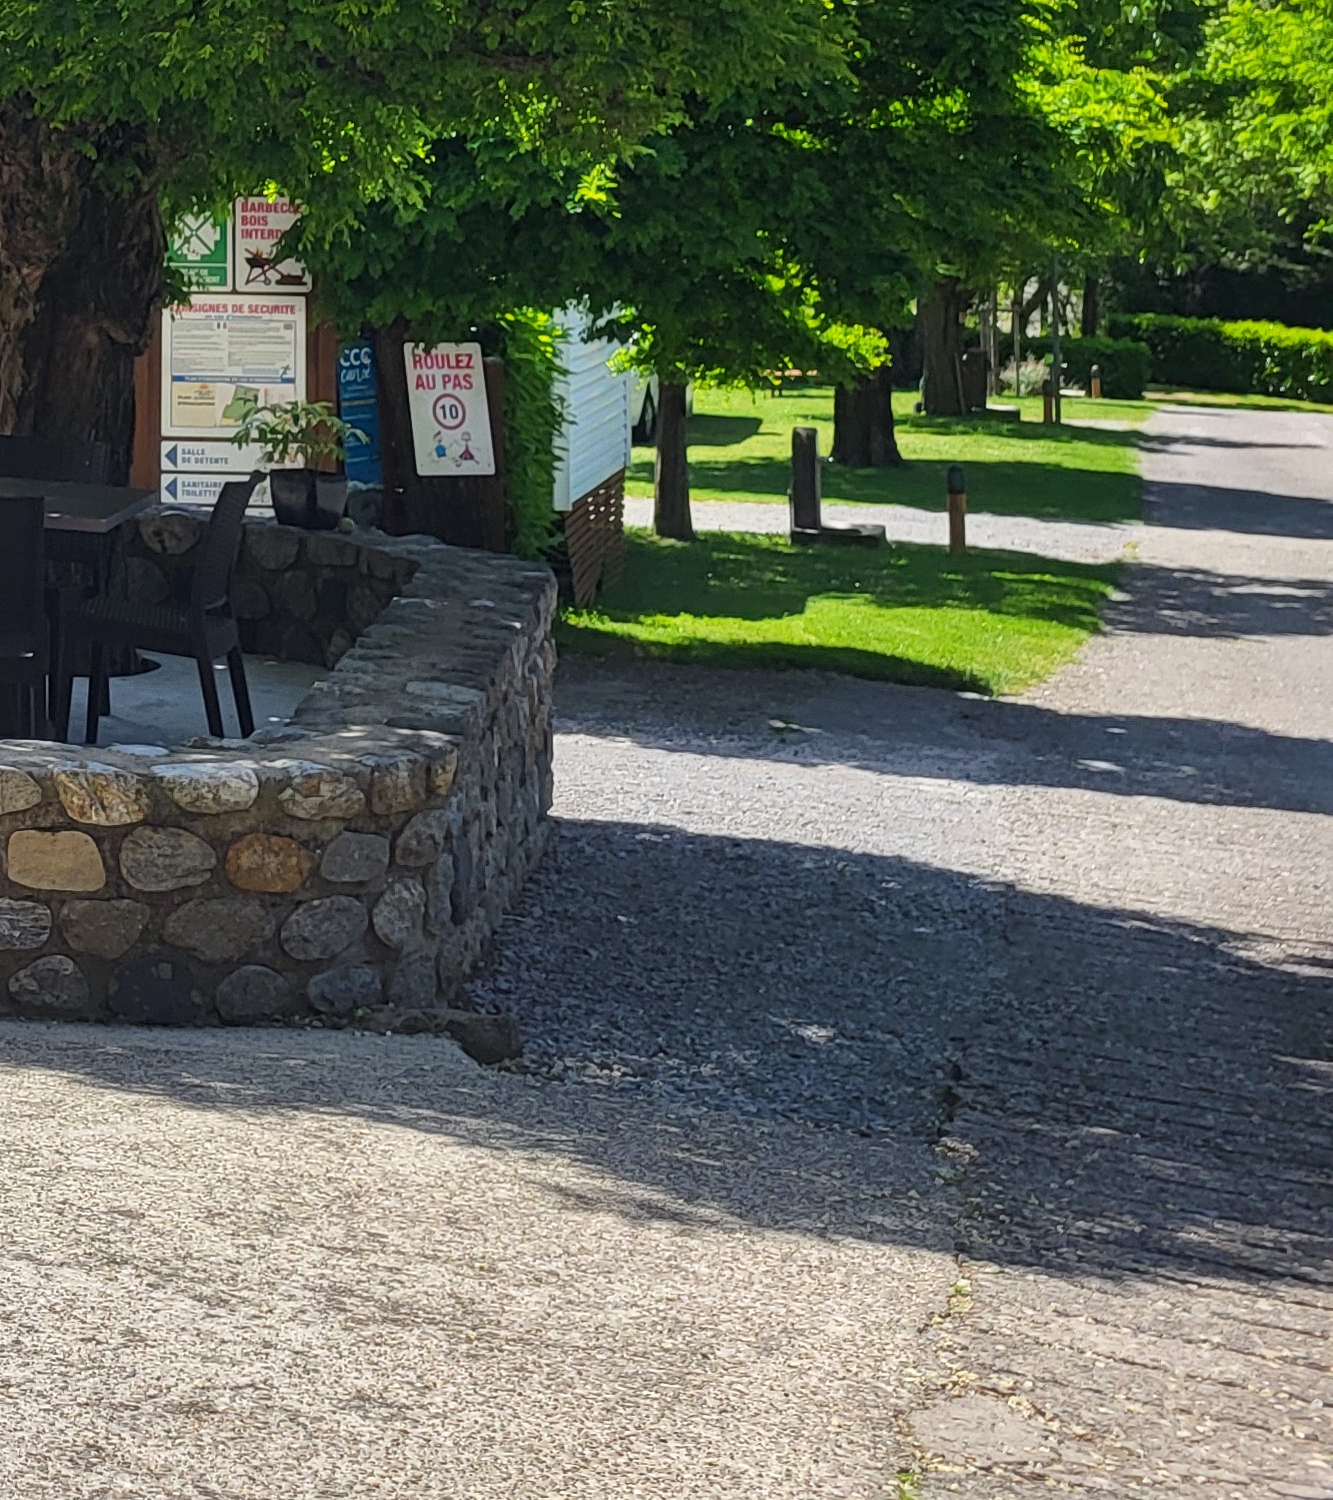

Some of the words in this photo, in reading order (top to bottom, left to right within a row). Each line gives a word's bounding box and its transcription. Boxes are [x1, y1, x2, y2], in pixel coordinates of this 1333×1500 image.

[241, 215, 268, 226] BOIS
[231, 304, 243, 313] DE
[248, 304, 296, 315] SECURITE
[413, 353, 475, 370] ROULEZ
[415, 374, 436, 390] AU
[442, 374, 474, 390] PAS
[439, 404, 459, 420] 10
[181, 448, 205, 456] SALLE
[194, 457, 229, 465] DETENTE
